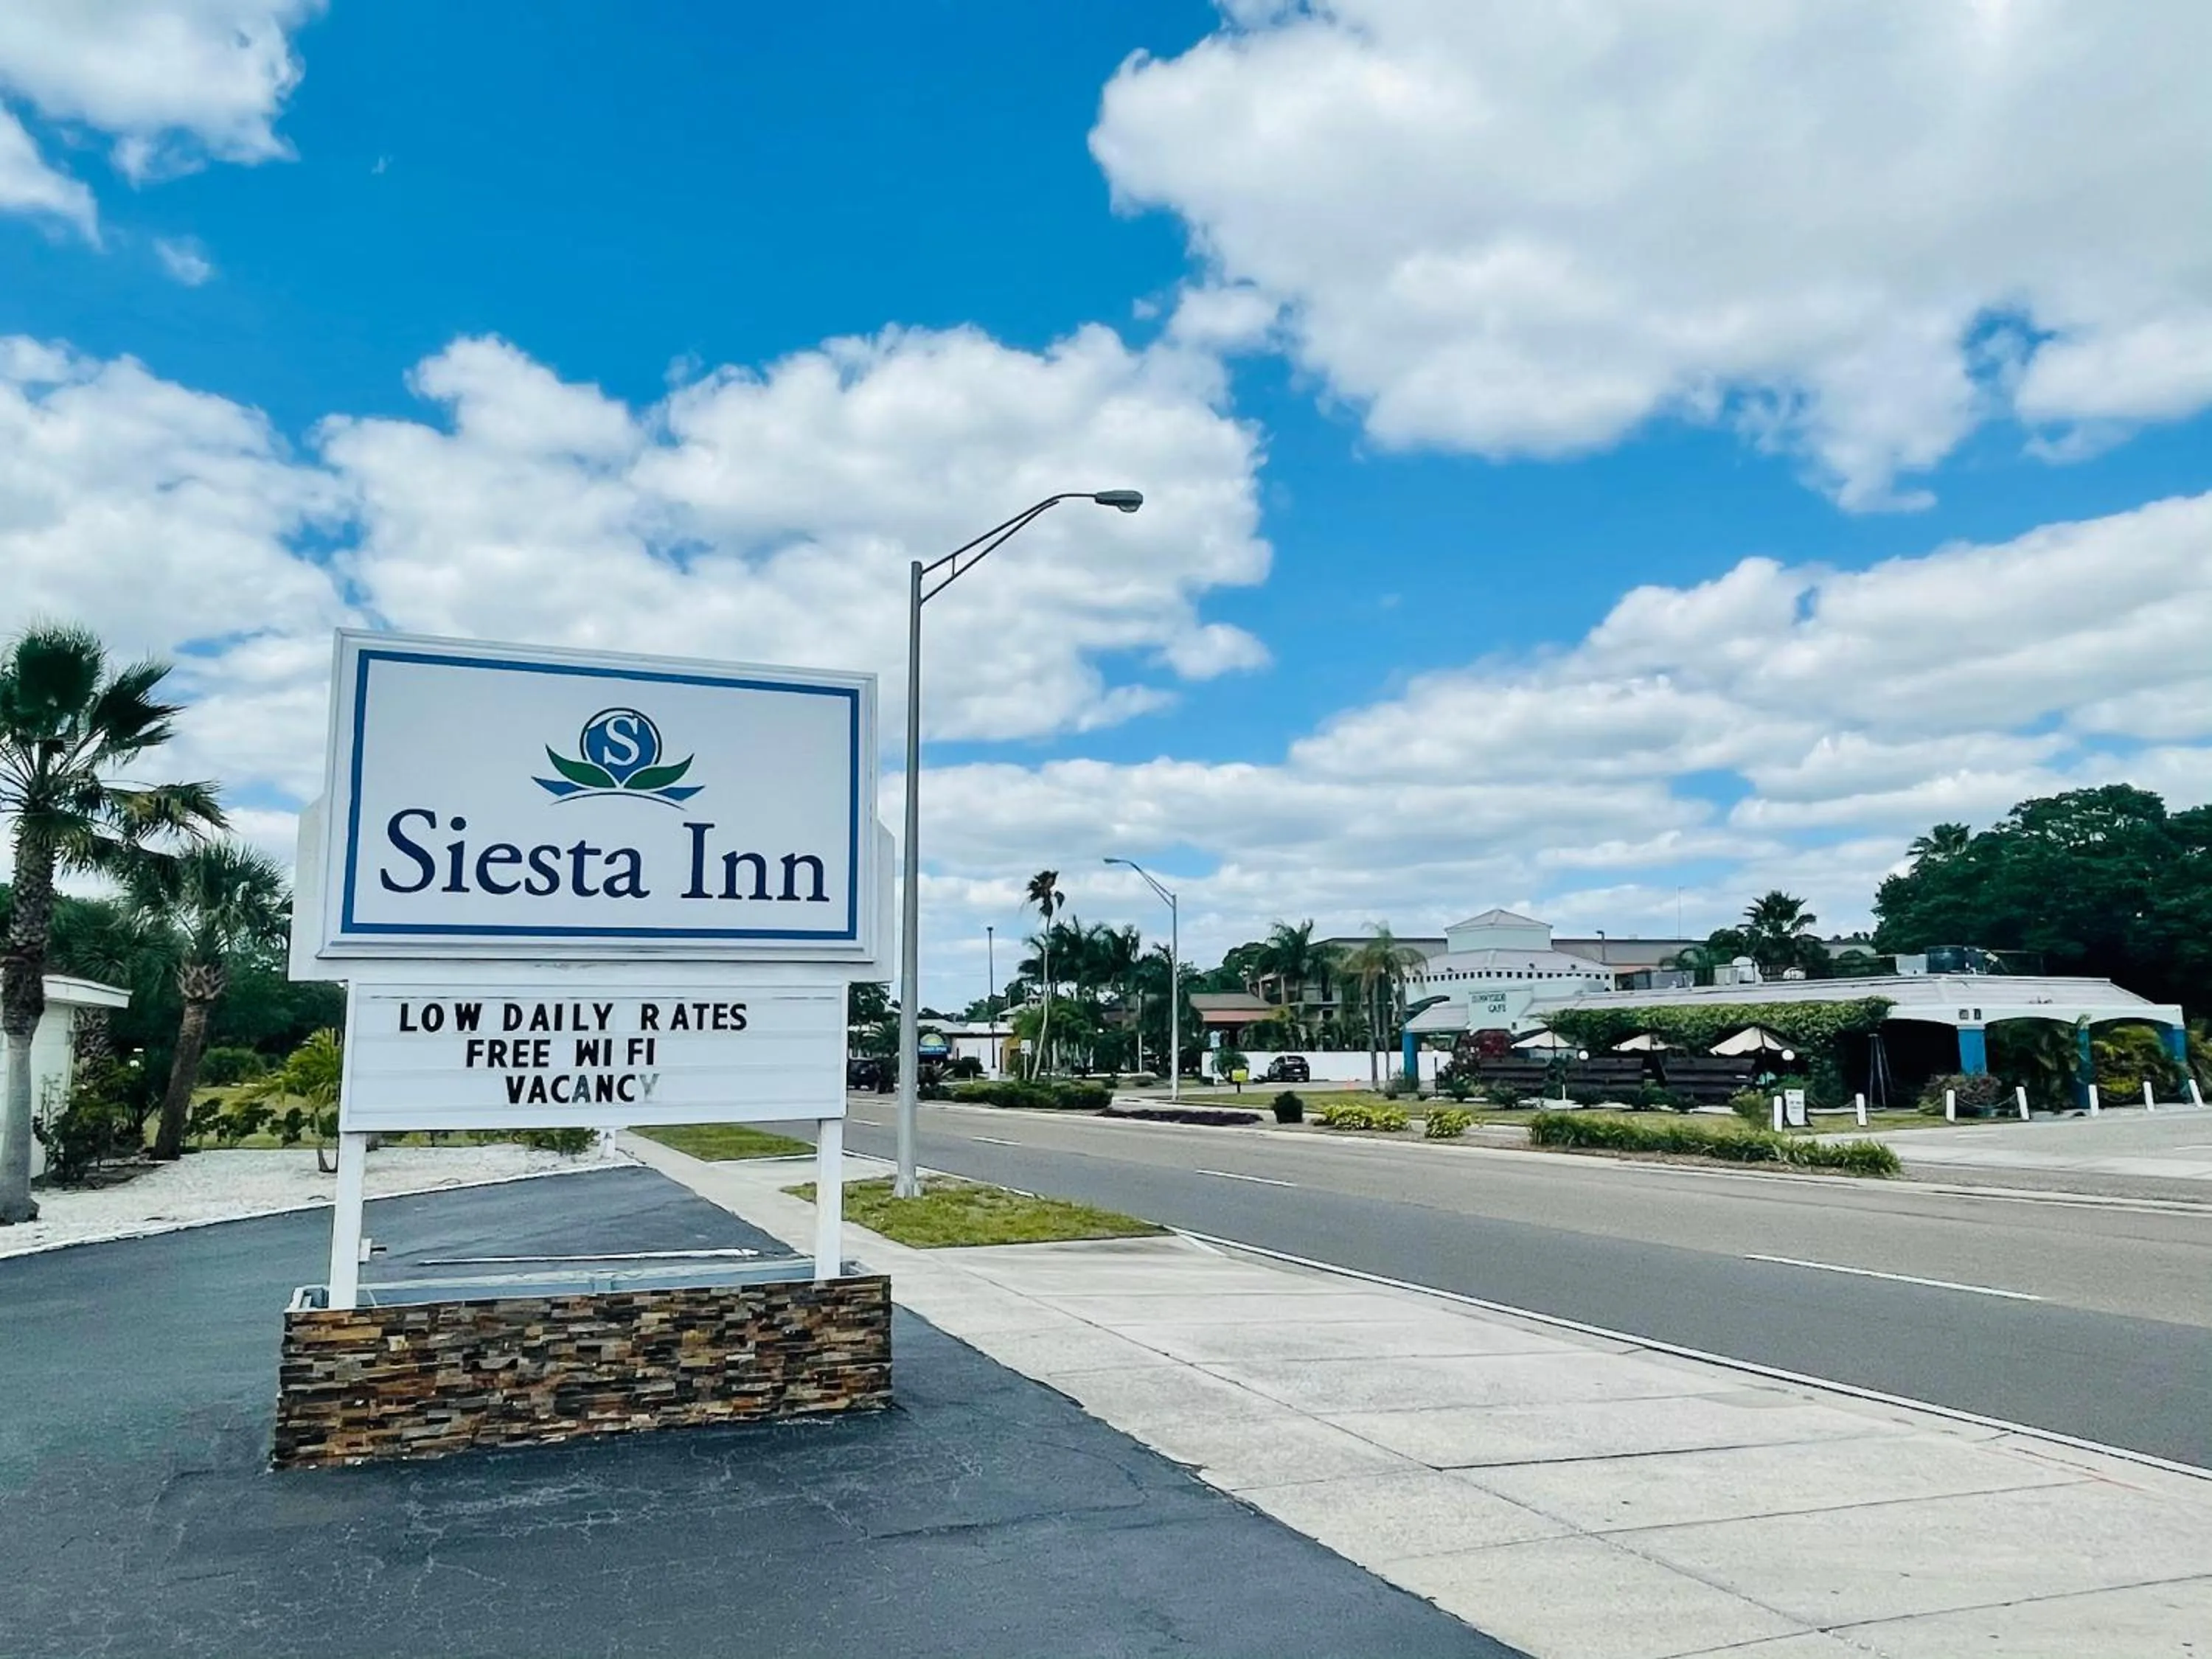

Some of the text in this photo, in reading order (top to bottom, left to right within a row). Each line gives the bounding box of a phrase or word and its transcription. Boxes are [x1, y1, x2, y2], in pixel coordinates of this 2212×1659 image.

[605, 716, 639, 765] S
[380, 808, 830, 902] Siesta Inn
[400, 1002, 747, 1034] LOW DAILY RATES
[466, 1039, 551, 1068] FREE
[505, 1074, 660, 1105] VACANCY
